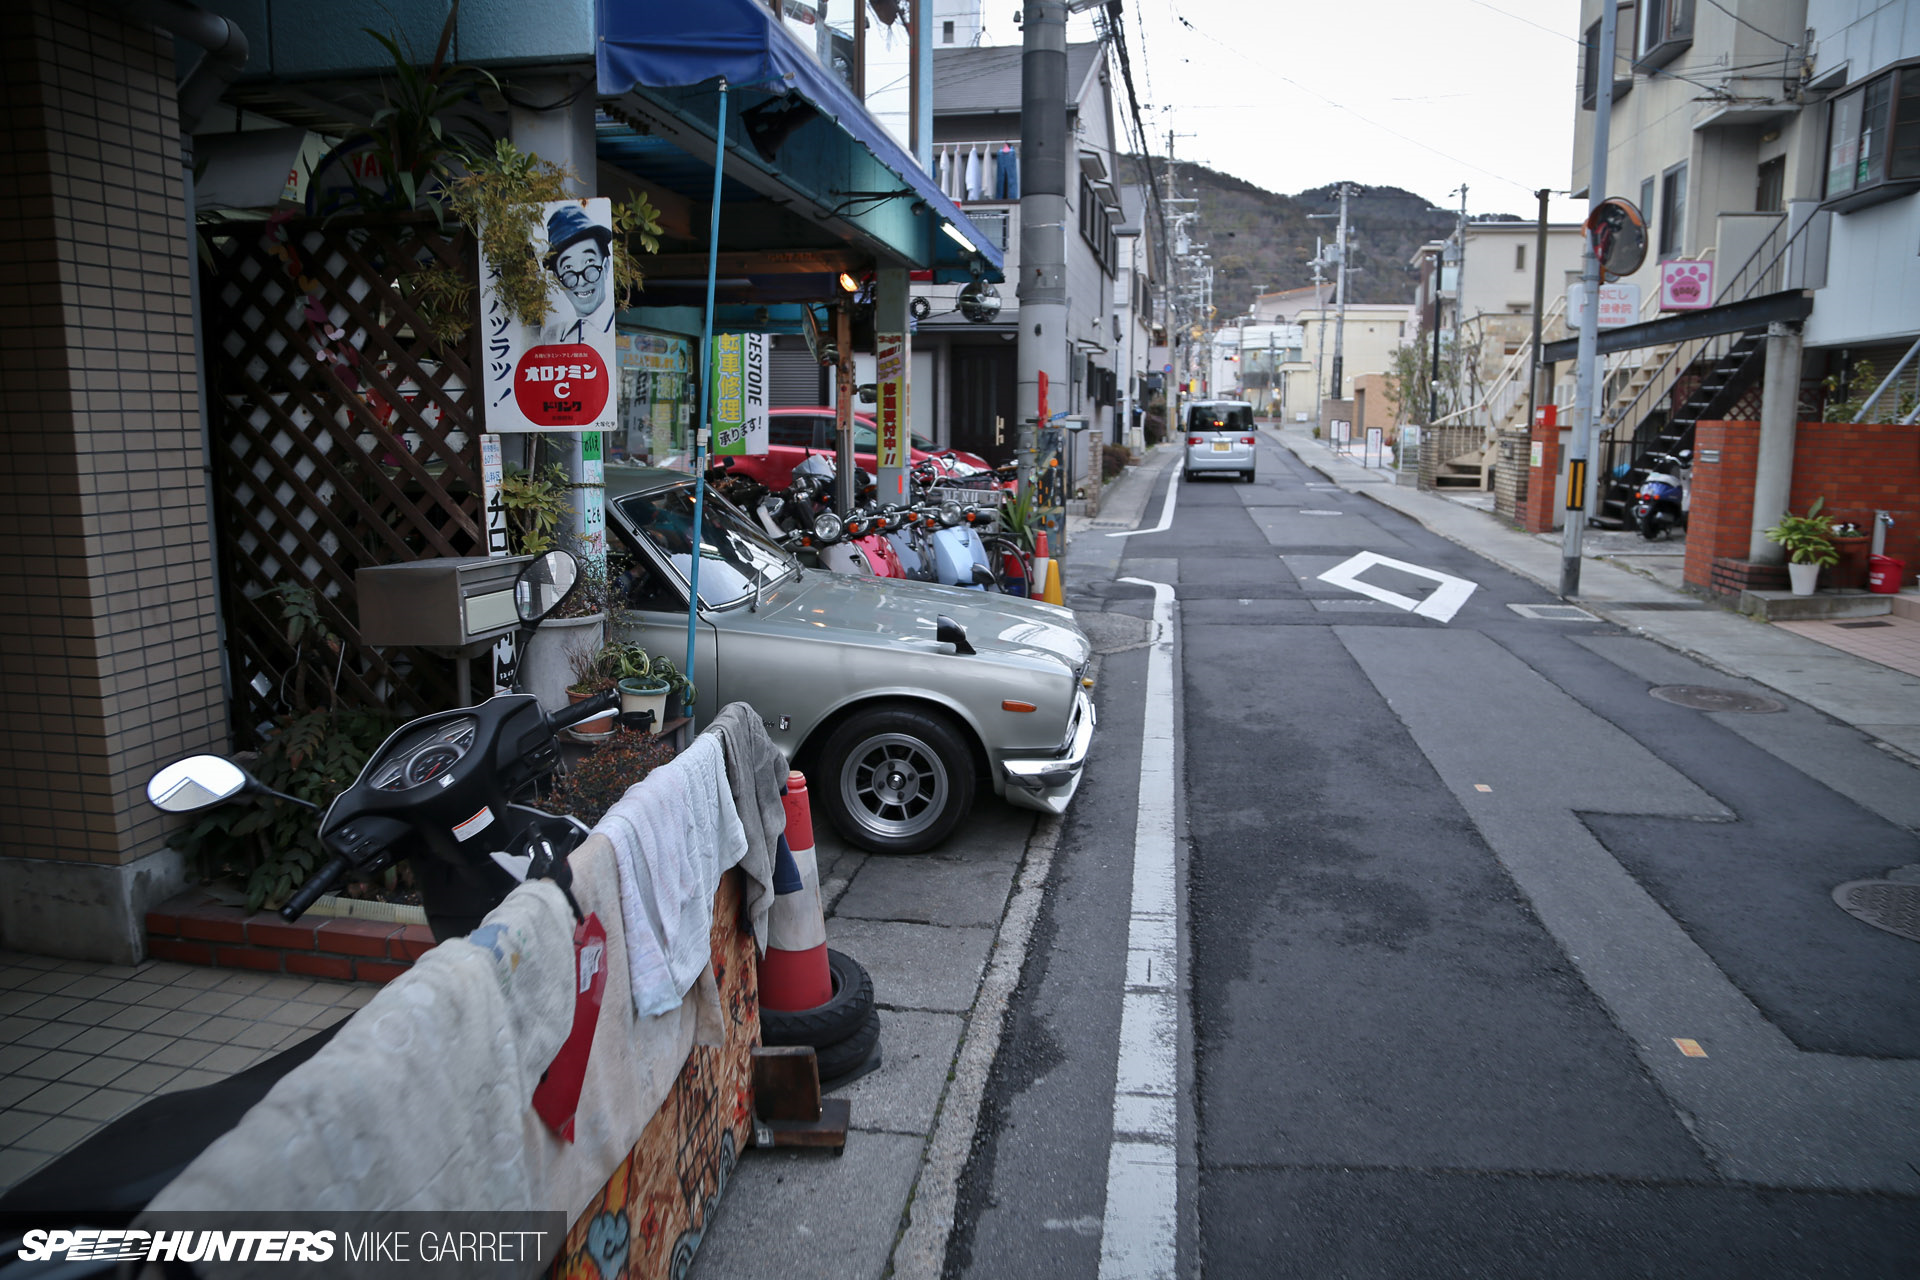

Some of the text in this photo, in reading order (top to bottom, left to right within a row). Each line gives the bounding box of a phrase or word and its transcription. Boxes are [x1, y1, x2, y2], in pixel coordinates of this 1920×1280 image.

[524, 363, 598, 382] オロナミン
[553, 382, 571, 399] C
[543, 401, 582, 412] ドリンク
